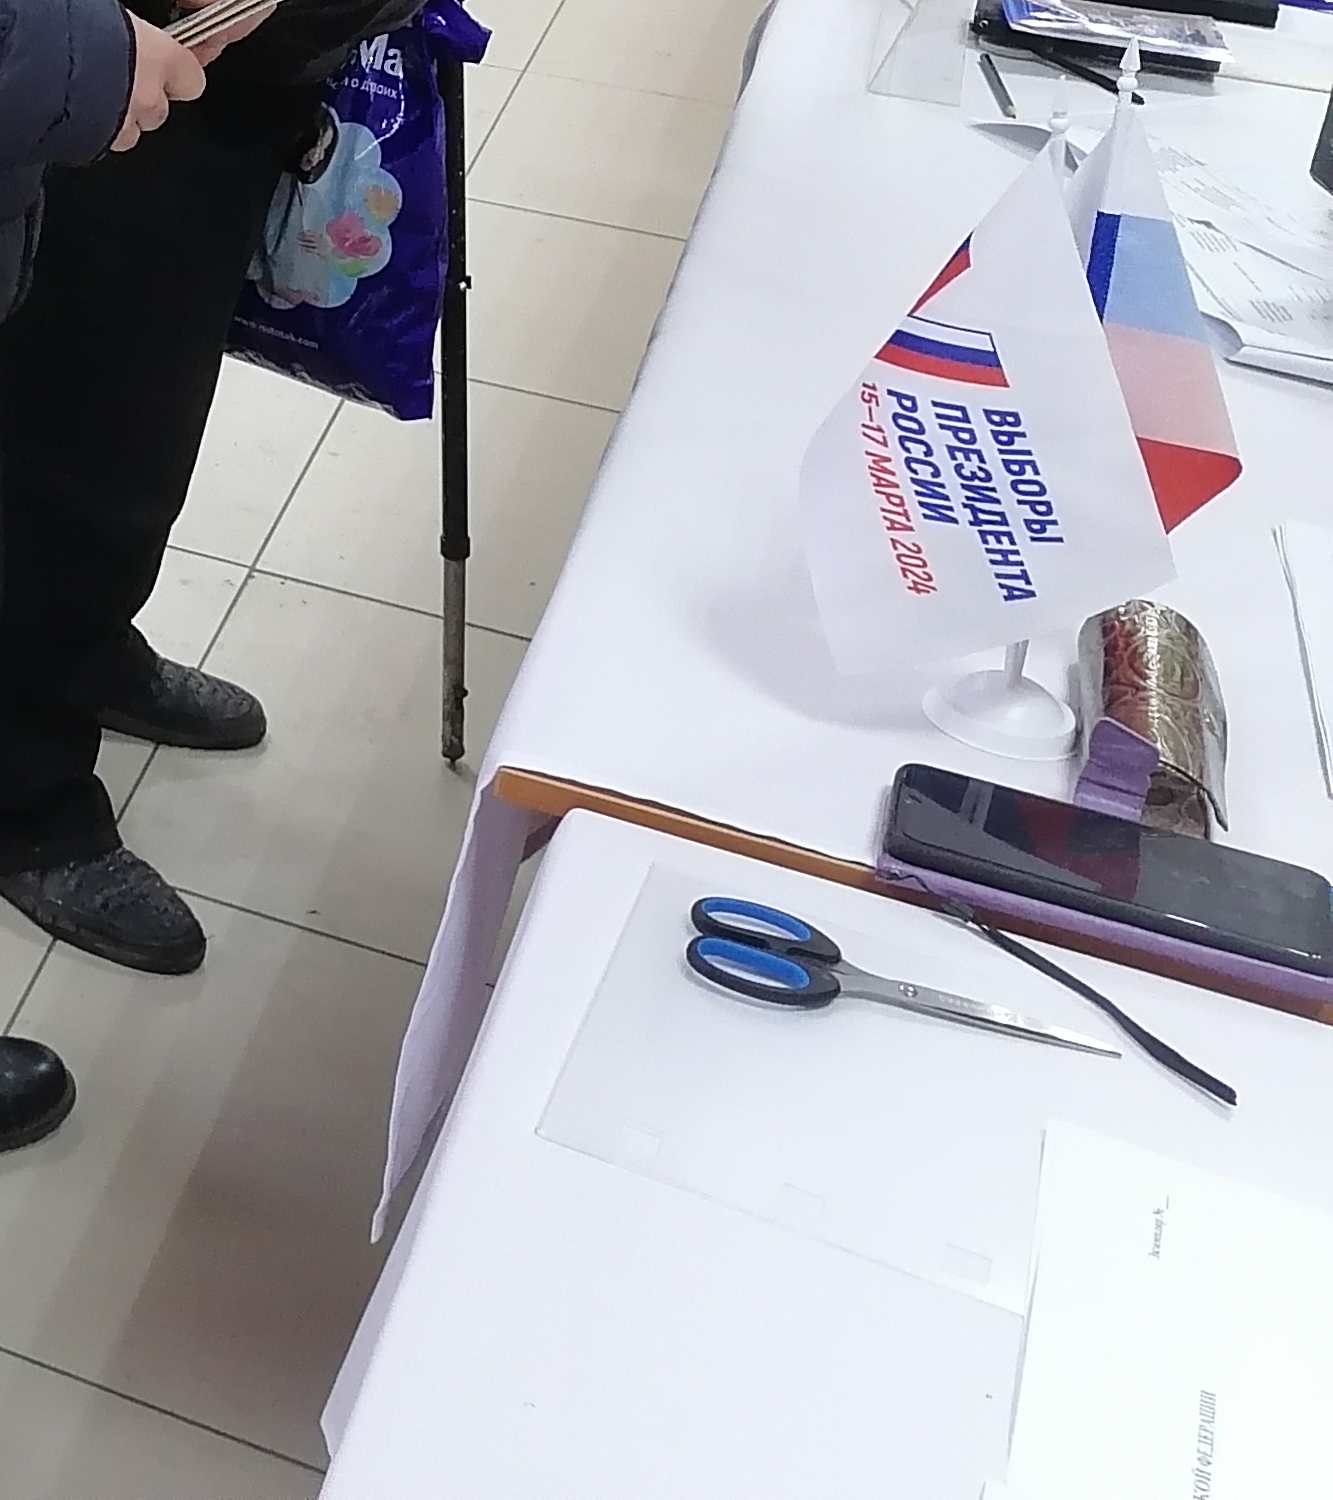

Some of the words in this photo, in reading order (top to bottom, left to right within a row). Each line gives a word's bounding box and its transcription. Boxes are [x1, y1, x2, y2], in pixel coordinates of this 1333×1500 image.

[865, 453, 914, 535] МАРТА
[886, 388, 958, 526] РОССИИ
[932, 399, 1036, 603] ПРЕЗИДЕНТА
[982, 408, 1065, 545] ВЫБОРЫ
[889, 534, 938, 597] 2024
